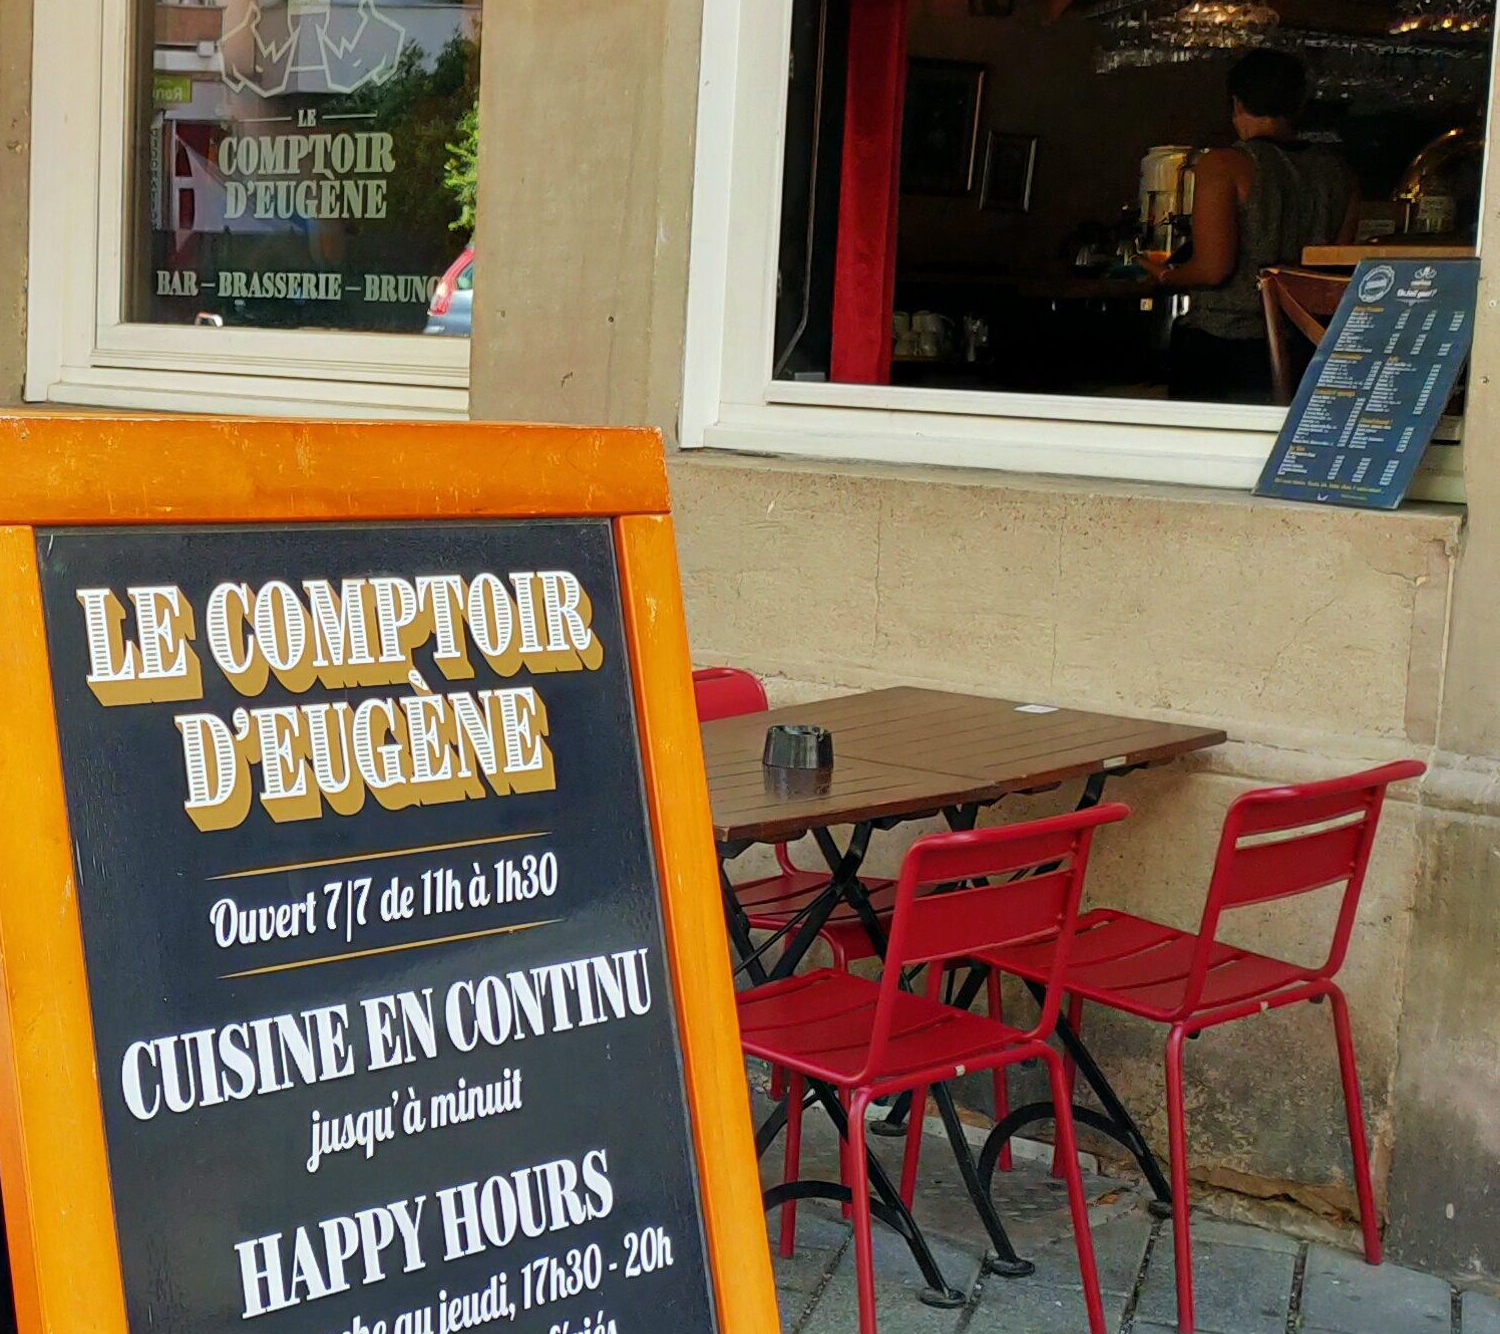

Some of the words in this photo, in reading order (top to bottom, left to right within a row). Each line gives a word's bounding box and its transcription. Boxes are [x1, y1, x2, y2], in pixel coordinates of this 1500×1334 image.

[218, 131, 396, 177] COMPTOIR
[297, 108, 317, 128] LE
[223, 170, 388, 220] D'EUGÈNE
[156, 269, 199, 297] BAR
[217, 270, 342, 301] BRASSERIE
[76, 585, 203, 707] LE
[206, 570, 604, 697] COMPTOIR
[174, 669, 557, 833] D'EUGÈNE
[208, 888, 317, 948] Ouvert
[380, 874, 415, 922] de
[421, 866, 461, 917] 11h
[468, 861, 491, 906] à
[494, 851, 559, 903] 1h30
[120, 1003, 355, 1121] CUISINE
[360, 988, 438, 1071] EN
[445, 947, 653, 1053] CONTINU
[429, 1067, 523, 1130] minuit
[234, 1194, 428, 1320] HAPPY
[436, 1148, 615, 1262] HOURS
[520, 1243, 603, 1312] 17h30
[622, 1225, 674, 1279] 20h
